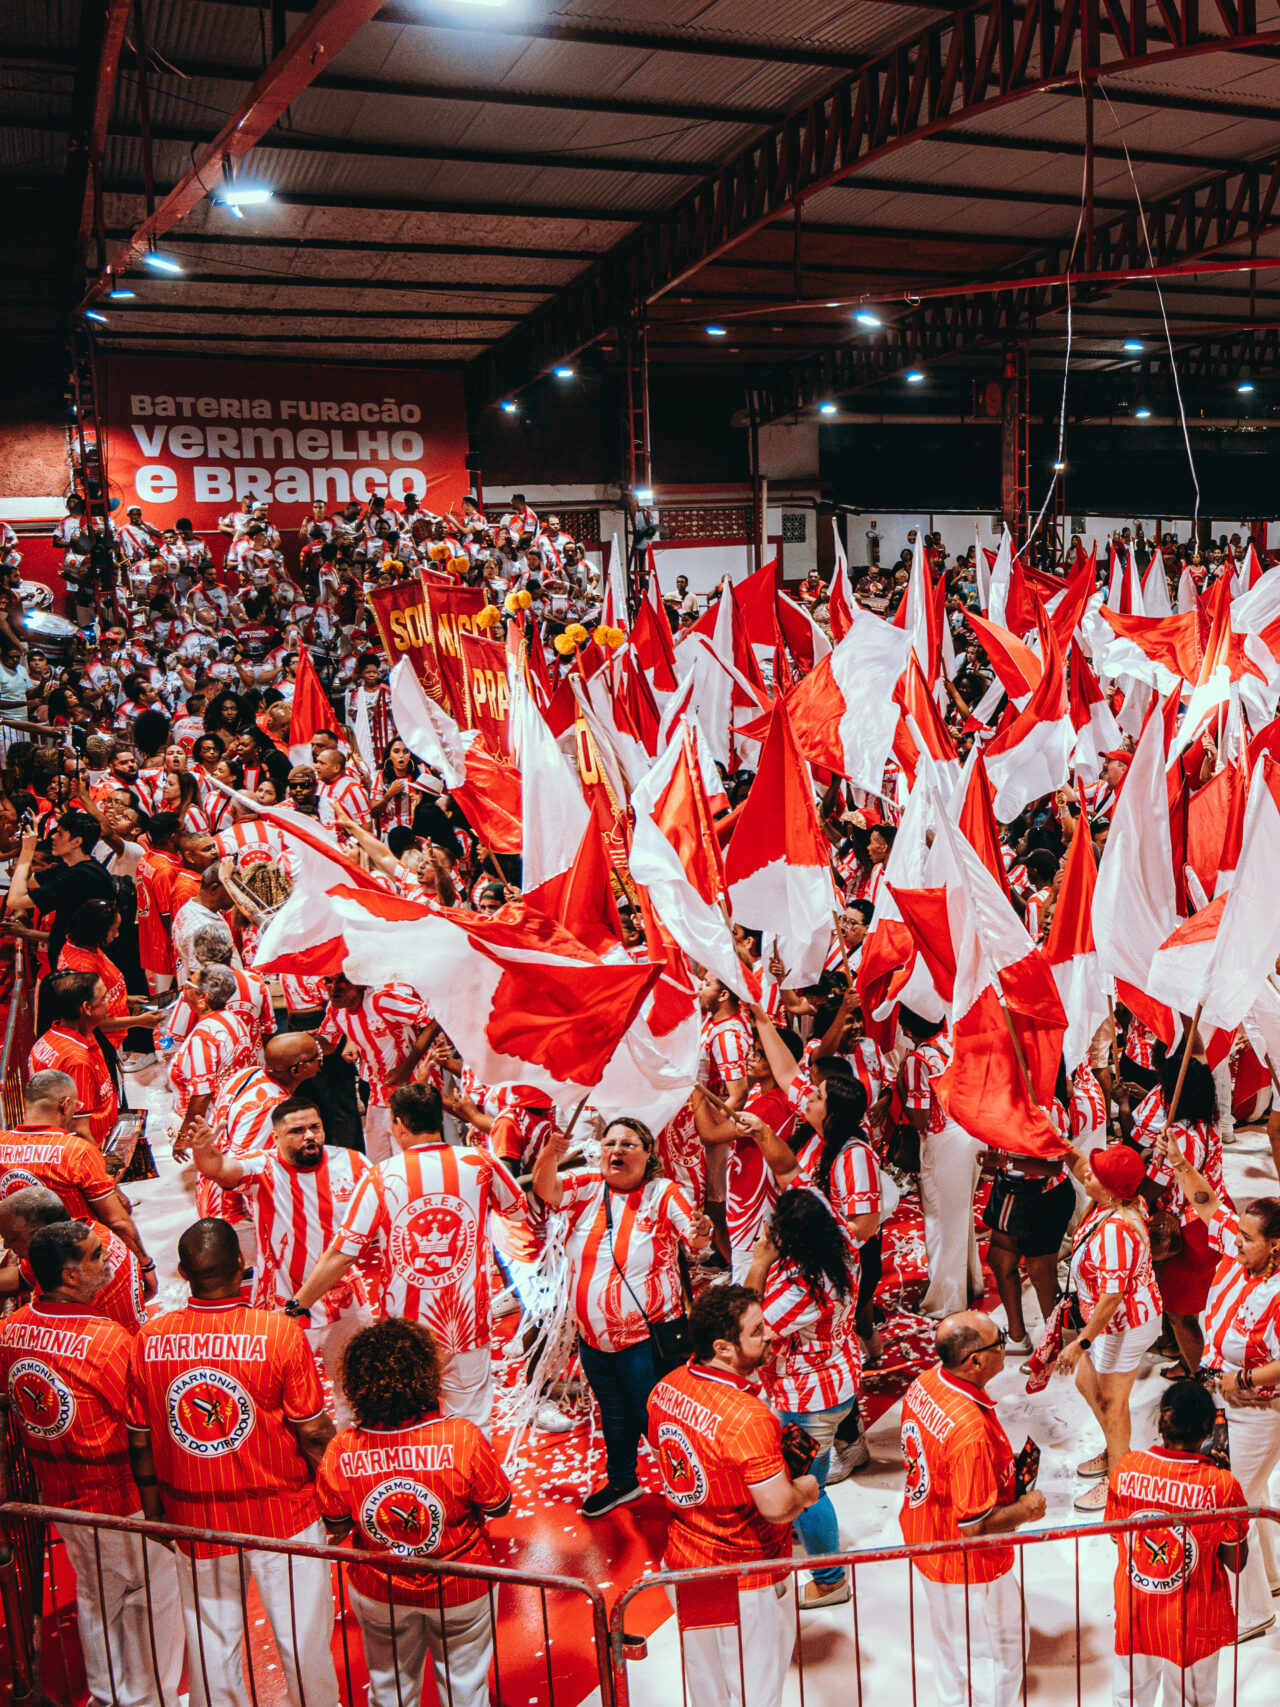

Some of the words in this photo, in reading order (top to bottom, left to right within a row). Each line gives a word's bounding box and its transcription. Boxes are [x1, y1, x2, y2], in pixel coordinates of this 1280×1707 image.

[407, 1273, 425, 1285] DO
[432, 1220, 476, 1286] VIRADOURO
[145, 1334, 268, 1361] HARMONIA
[12, 1362, 56, 1386] HARMONIA
[169, 1398, 189, 1443] UNIDOS
[189, 1441, 208, 1453] DO
[211, 1397, 250, 1452] VIRADOURO
[341, 1445, 453, 1477] HARMONIA
[1118, 1472, 1216, 1509] HARMONIA
[1133, 1575, 1149, 1587] DO
